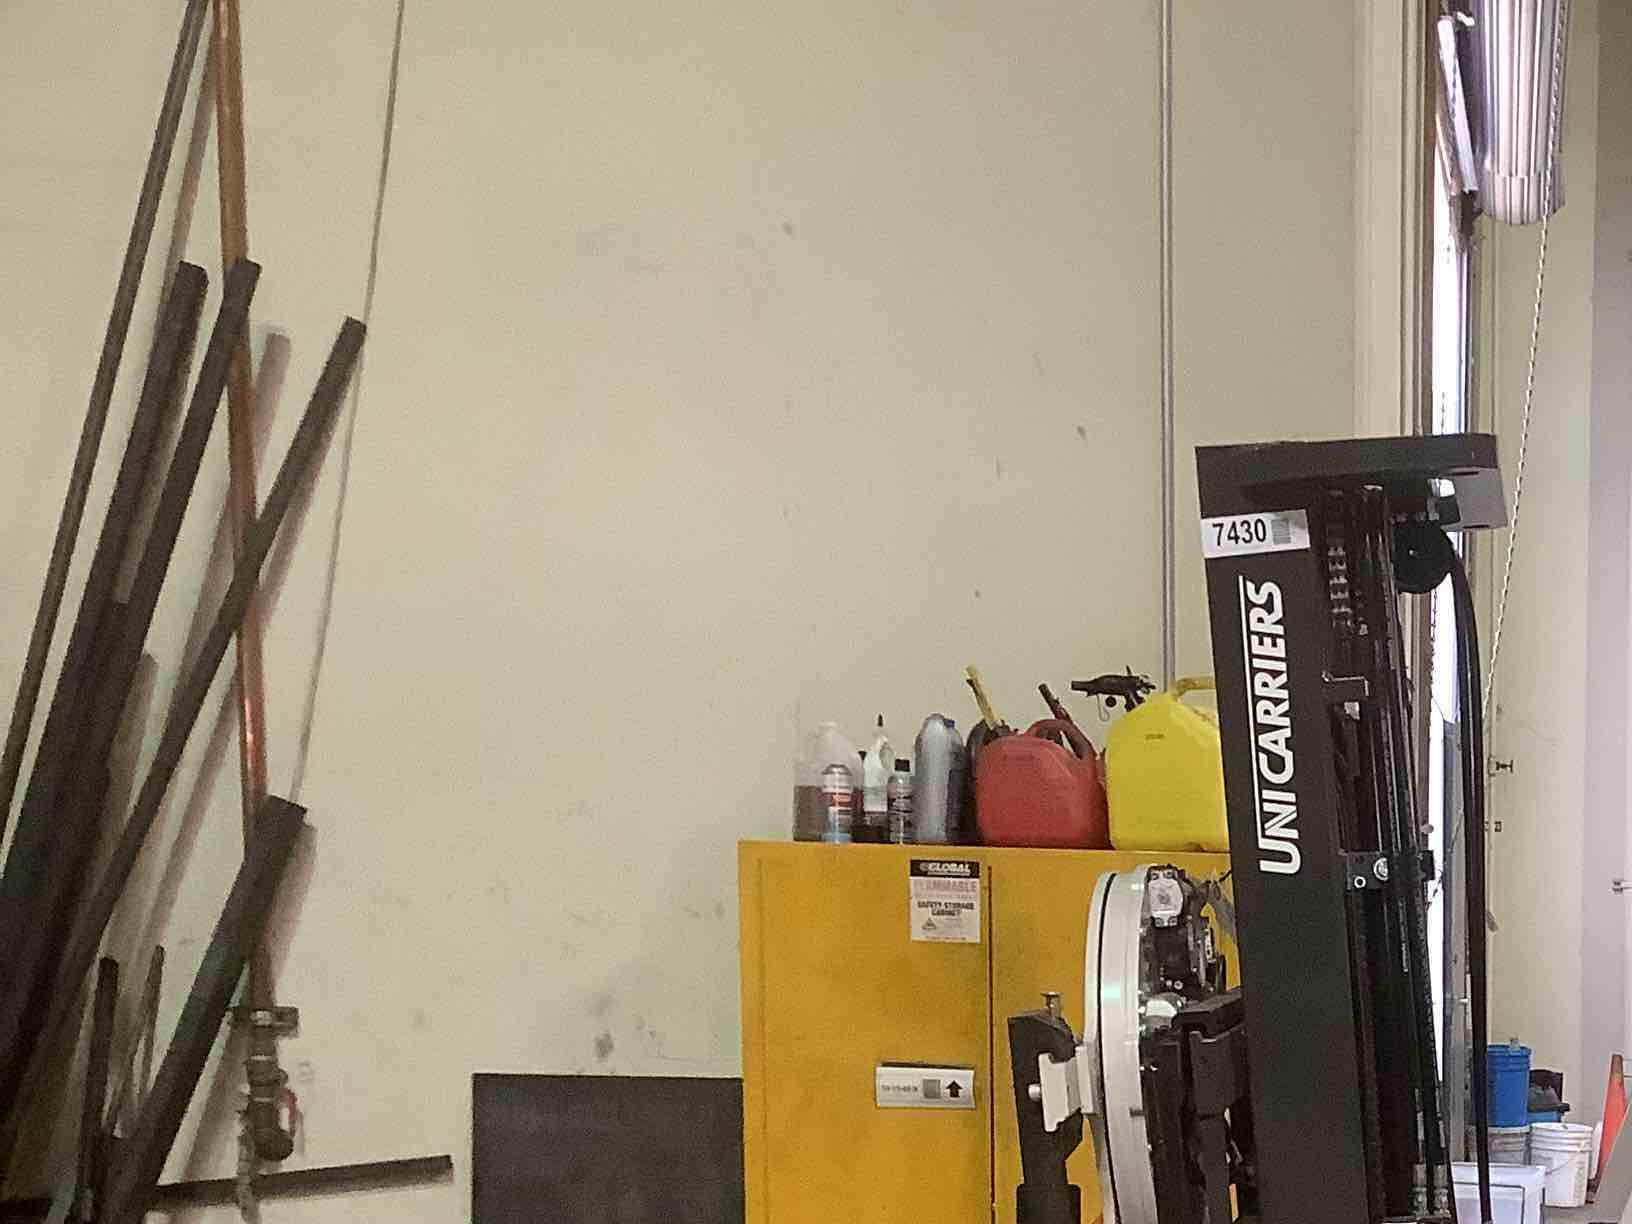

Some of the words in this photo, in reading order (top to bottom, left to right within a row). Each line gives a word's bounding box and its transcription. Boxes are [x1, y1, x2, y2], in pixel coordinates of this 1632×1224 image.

[1212, 518, 1267, 546] 7430
[1244, 578, 1301, 875] UNICARRIERS
[927, 862, 971, 873] GLOBAL
